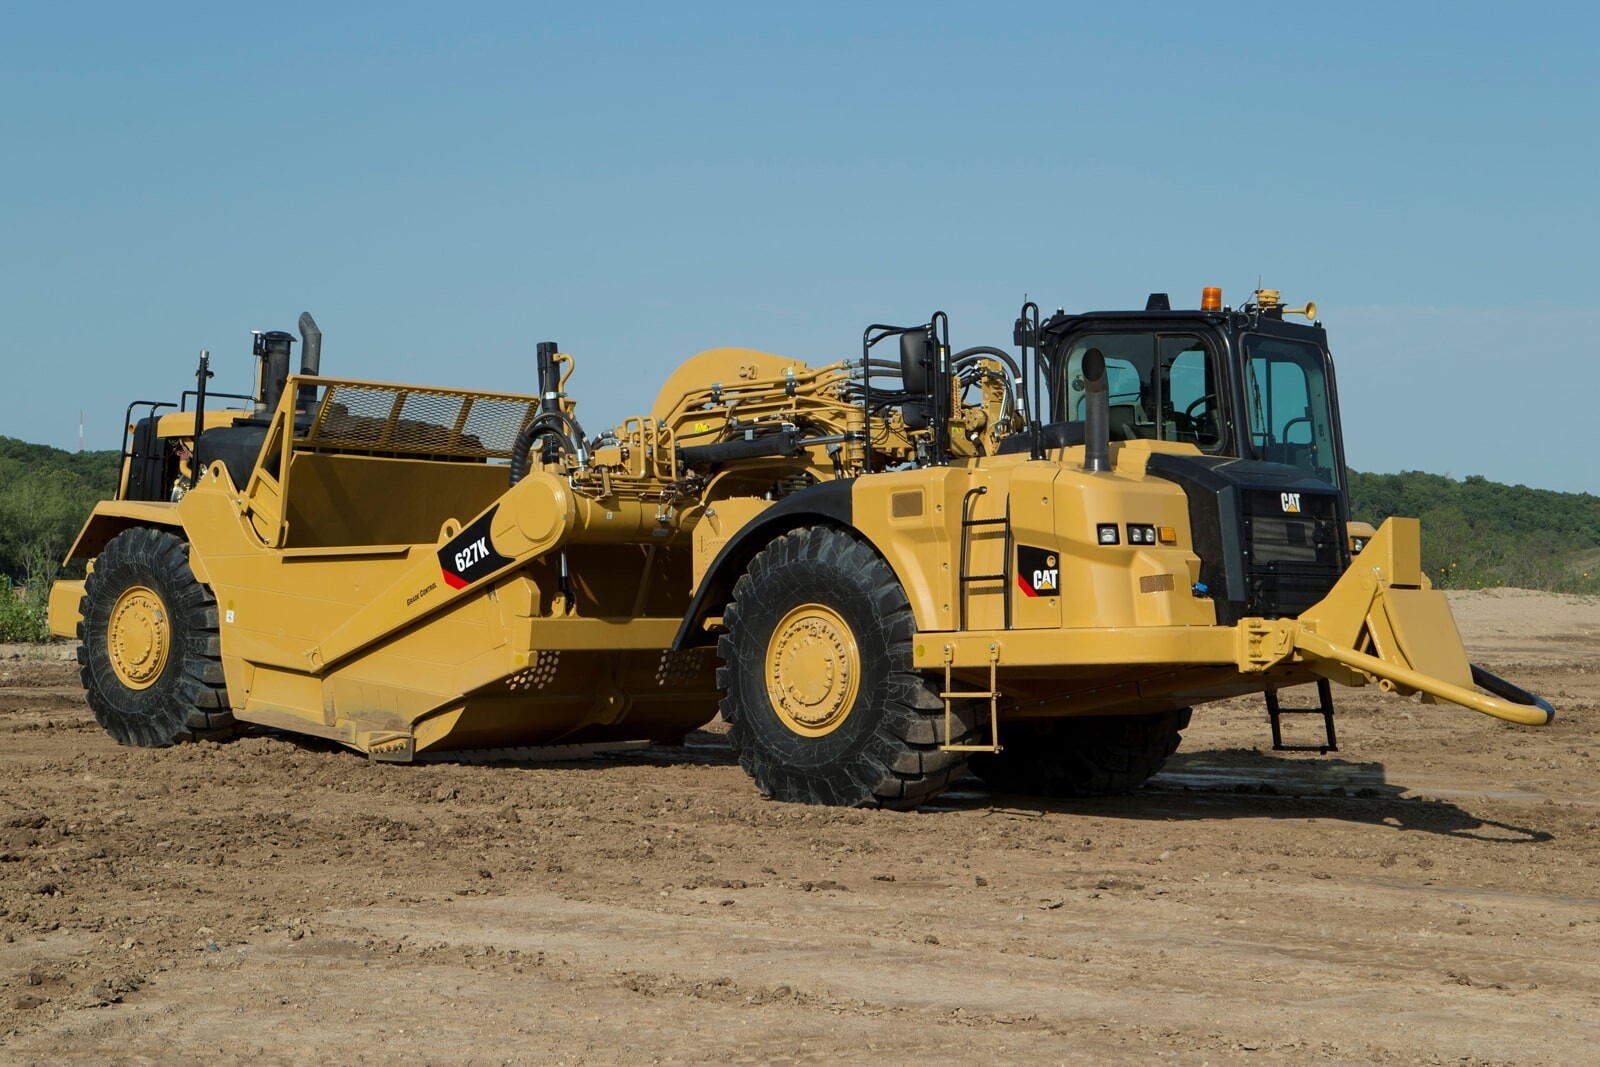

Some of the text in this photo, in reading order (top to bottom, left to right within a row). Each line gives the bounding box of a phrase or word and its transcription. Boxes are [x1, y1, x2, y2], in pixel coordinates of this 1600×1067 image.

[1281, 492, 1300, 512] CAT
[455, 536, 490, 572] 627K
[1033, 569, 1058, 590] CAT
